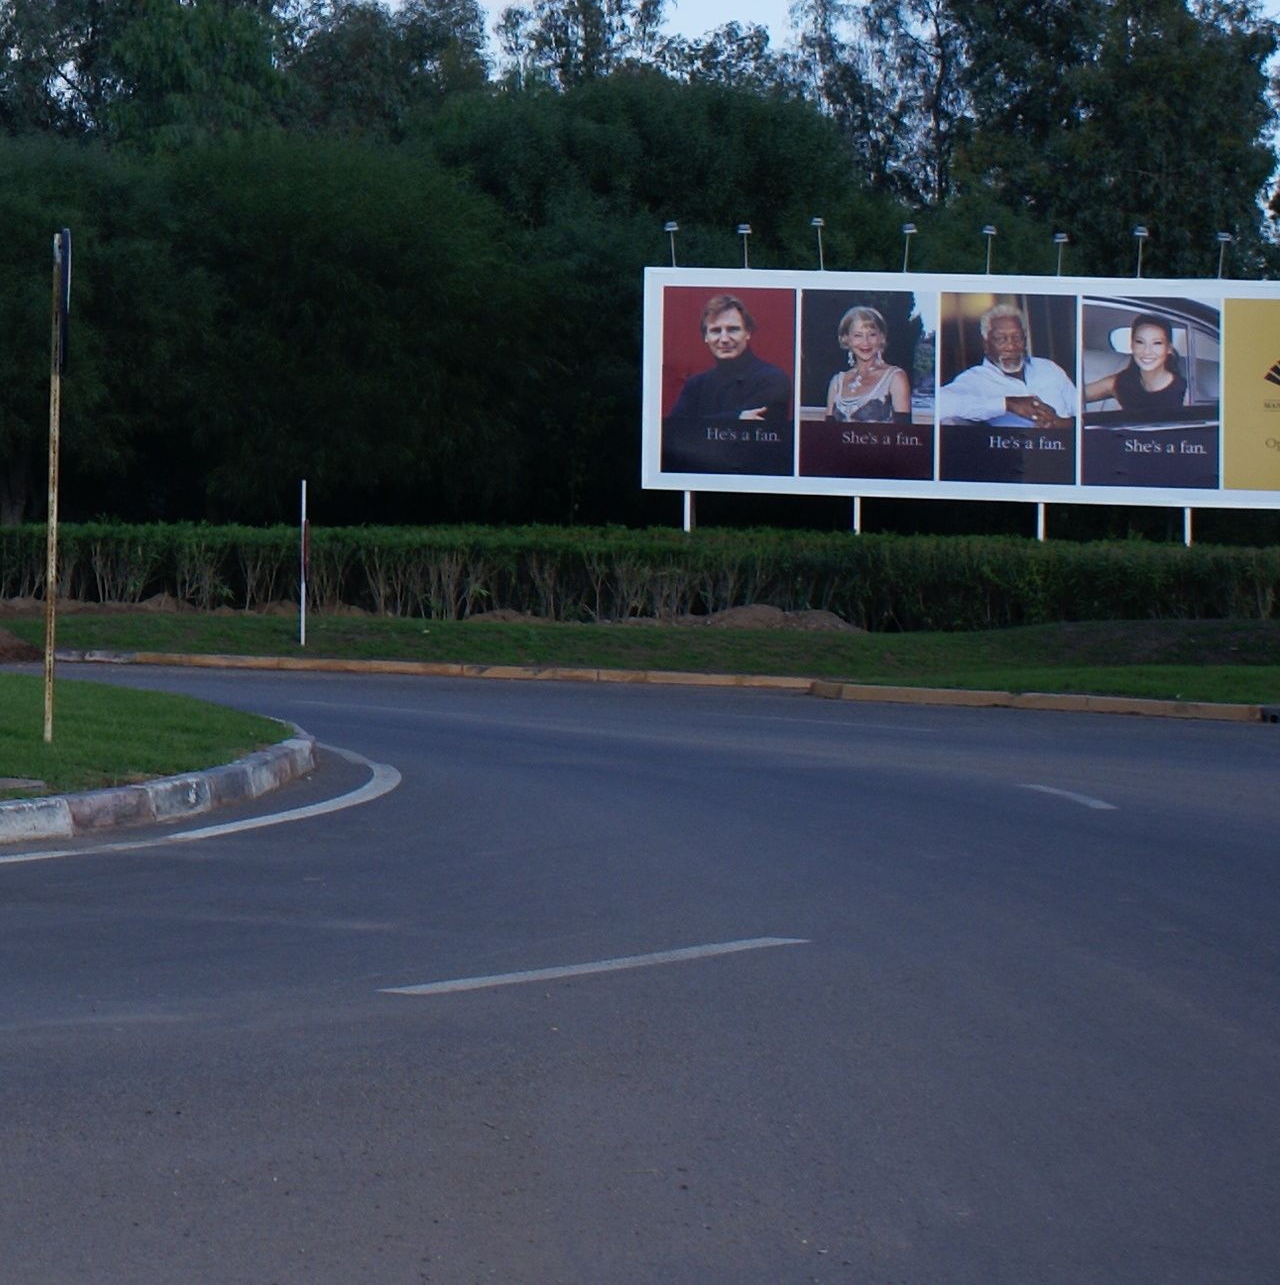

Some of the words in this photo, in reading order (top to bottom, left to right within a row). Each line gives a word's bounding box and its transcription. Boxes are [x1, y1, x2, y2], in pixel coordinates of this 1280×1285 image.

[706, 427, 737, 442] He's
[741, 432, 750, 442] a
[755, 427, 782, 443] fan.
[841, 431, 878, 445] She's
[882, 434, 891, 445] a
[895, 431, 923, 447] fan.
[989, 435, 1020, 449] He's
[1024, 440, 1034, 450] a
[1039, 436, 1066, 451] fan.
[1124, 439, 1161, 453] She's
[1165, 444, 1175, 454] a
[1180, 440, 1207, 455] fan.
